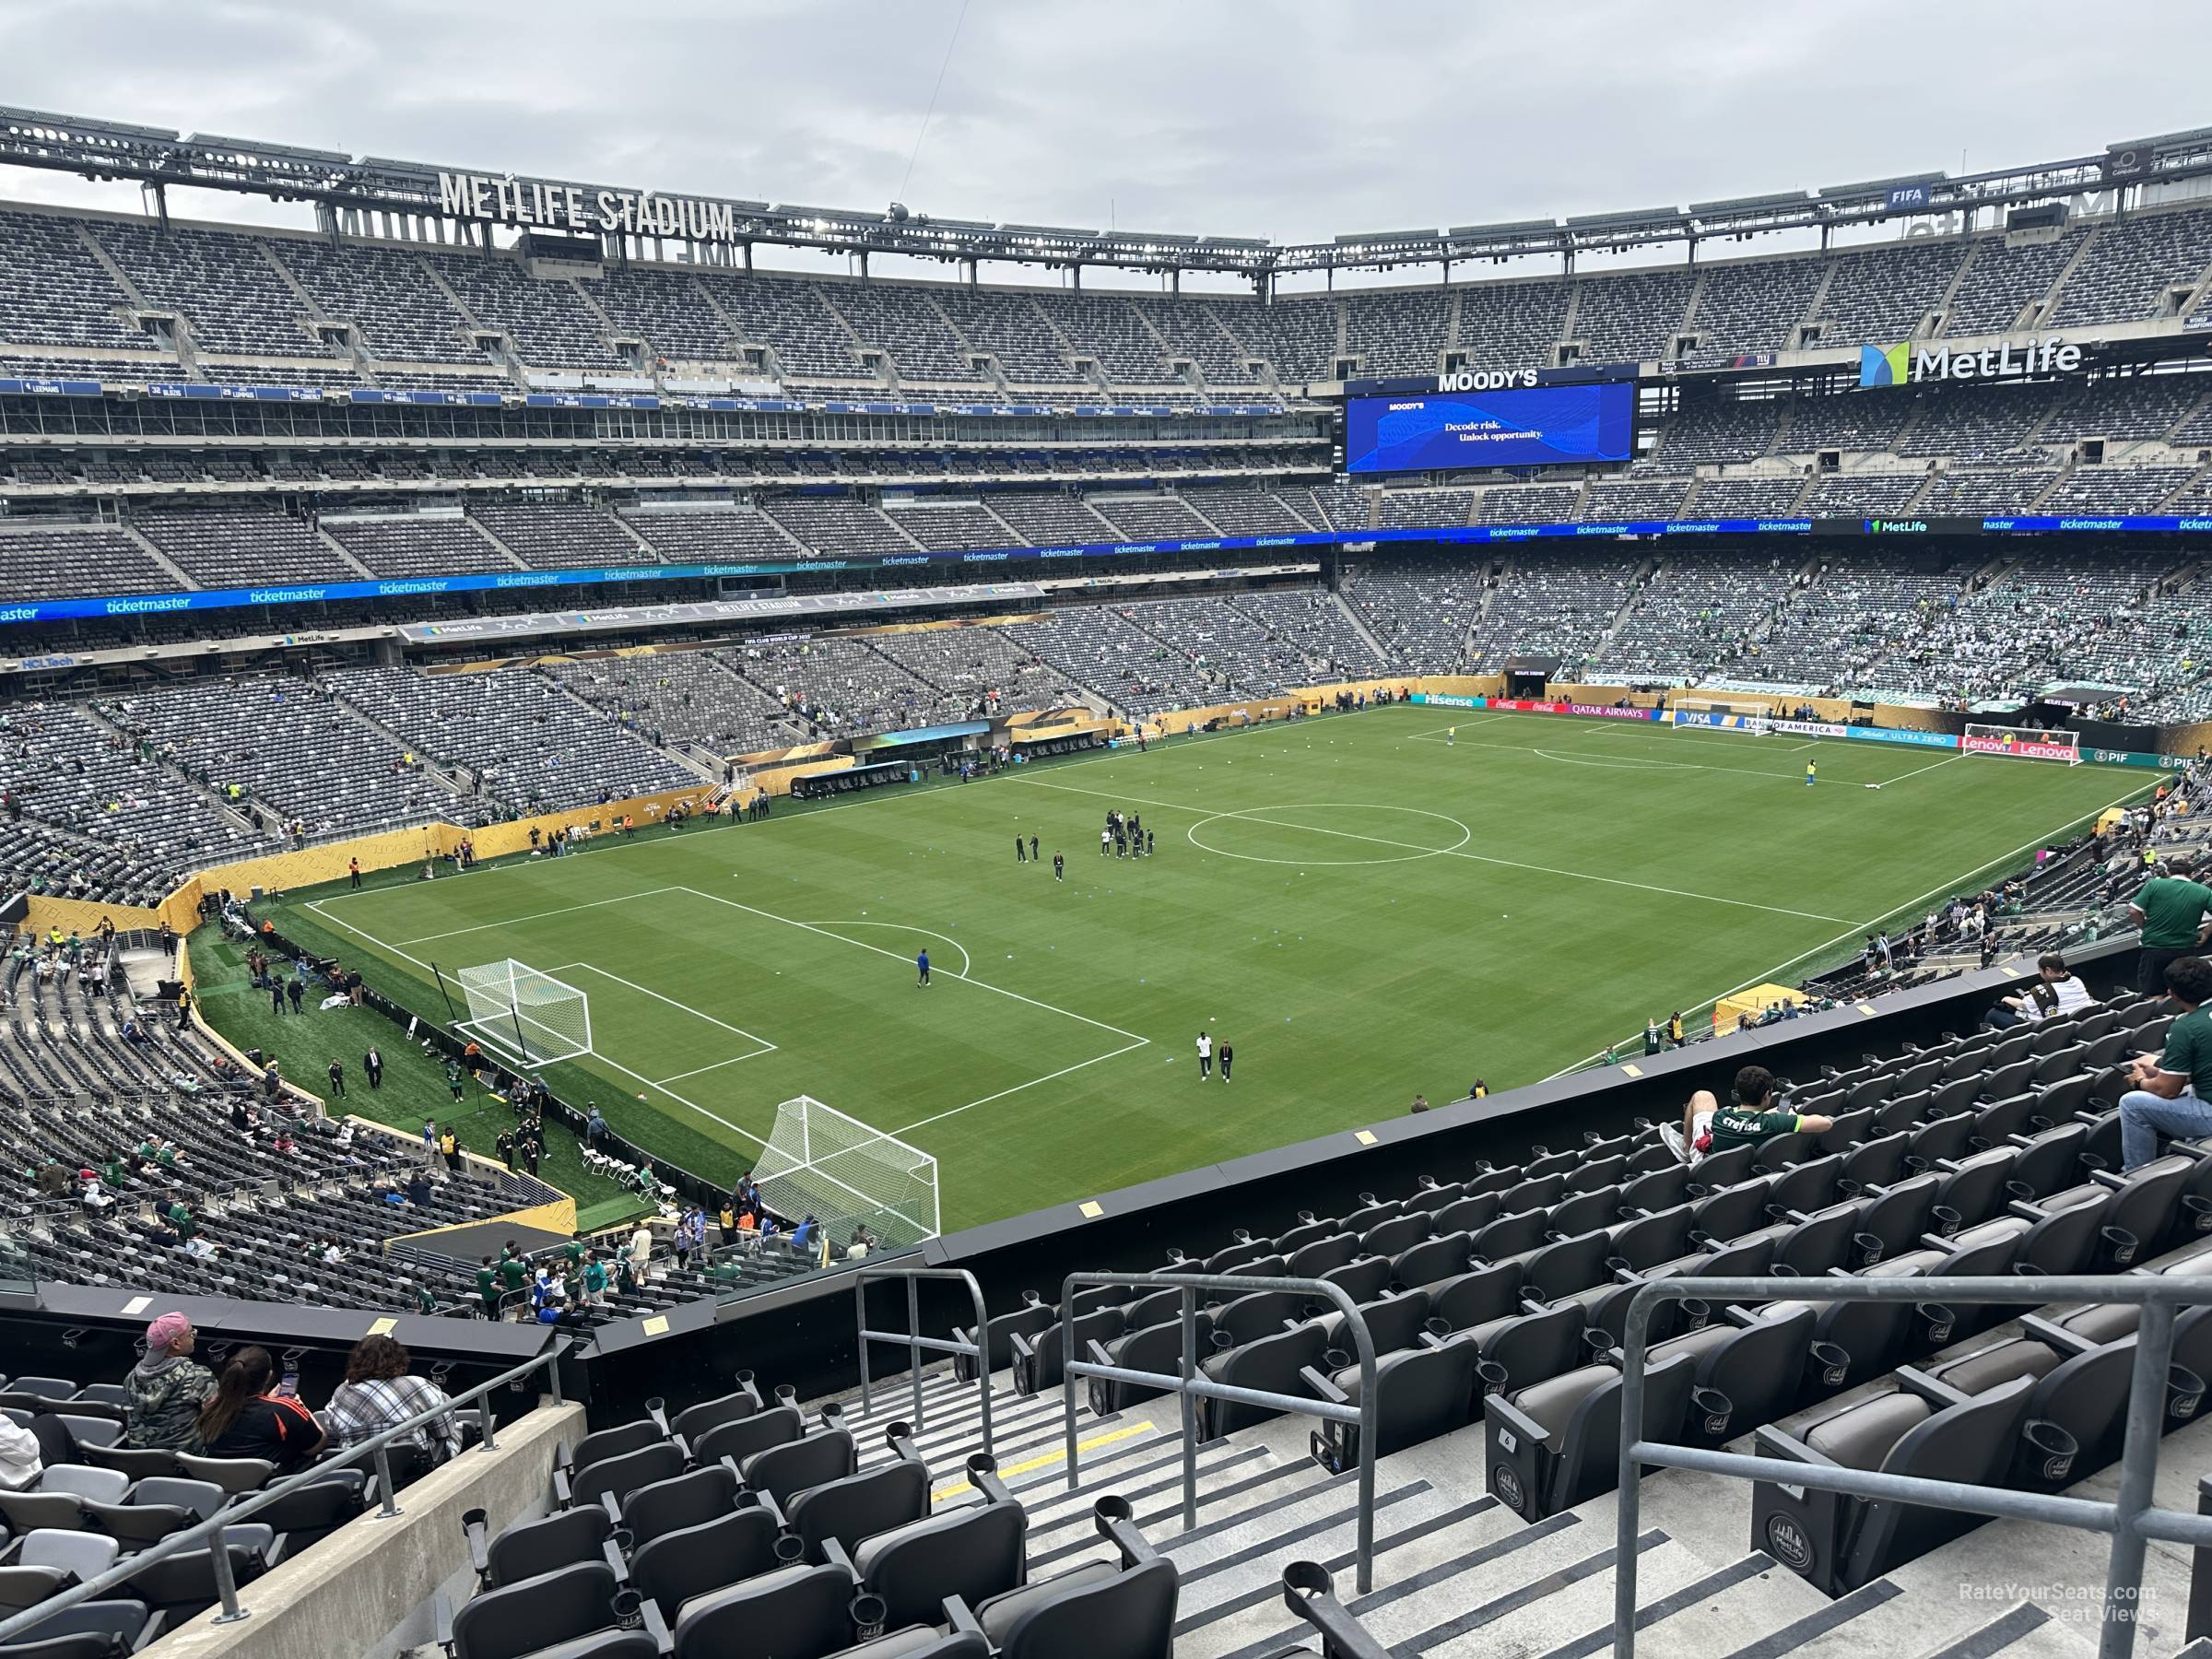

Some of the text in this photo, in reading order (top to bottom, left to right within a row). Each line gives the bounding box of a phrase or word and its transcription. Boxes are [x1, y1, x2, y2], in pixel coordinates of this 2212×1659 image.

[1892, 189, 1923, 203] FIFA
[438, 172, 587, 228] METLIFE
[597, 191, 735, 243] STADIUM
[1914, 336, 2082, 382] MetLife
[1438, 370, 1537, 393] MOODY'S
[151, 386, 161, 394] 32
[1389, 403, 1425, 411] MOODY'S
[1445, 421, 1501, 431] Decode risk.
[1459, 430, 1544, 441] Unlock opportunity.
[1576, 524, 1629, 534] ticketmaster
[1666, 524, 1719, 532] ticketmaster
[1882, 521, 1927, 532] MetLife
[2060, 520, 2124, 529] ticketmaster
[1489, 527, 1540, 537] ticketmaster
[1181, 541, 1221, 550] ticketmaster
[1256, 536, 1296, 546] ticketmaster
[1041, 548, 1084, 558] ticketmaster
[1114, 544, 1156, 554] ticketmaster
[882, 556, 930, 566] ticketmaster
[963, 552, 1008, 562] ticketmaster
[703, 564, 758, 575] ticketmaster
[796, 560, 847, 571] ticketmaster
[605, 568, 663, 580] ticketmaster
[497, 574, 559, 586] ticketmaster
[378, 580, 448, 594] ticketmaster
[250, 587, 325, 603] ticketmaster
[106, 597, 191, 614] ticketmaster
[714, 600, 802, 614] METLIFE STADIUM
[591, 613, 629, 622] MetLife
[441, 624, 483, 633] MetLife
[297, 633, 325, 644] MetLife
[21, 655, 74, 670] HCLTech
[1425, 694, 1474, 707] Hisense
[1572, 704, 1643, 718] QATAR AIRWAYS
[1685, 712, 1711, 724] VISA
[1787, 723, 1831, 734] AMERICA
[1891, 731, 1918, 741] ULTRA
[1922, 735, 1947, 745] ZERO
[2020, 743, 2072, 759] Lenovo
[2108, 753, 2128, 762] PIF
[1722, 1117, 1761, 1133] crefisa
[1504, 1436, 1510, 1445] 6
[1776, 1535, 1804, 1559] MetLife
